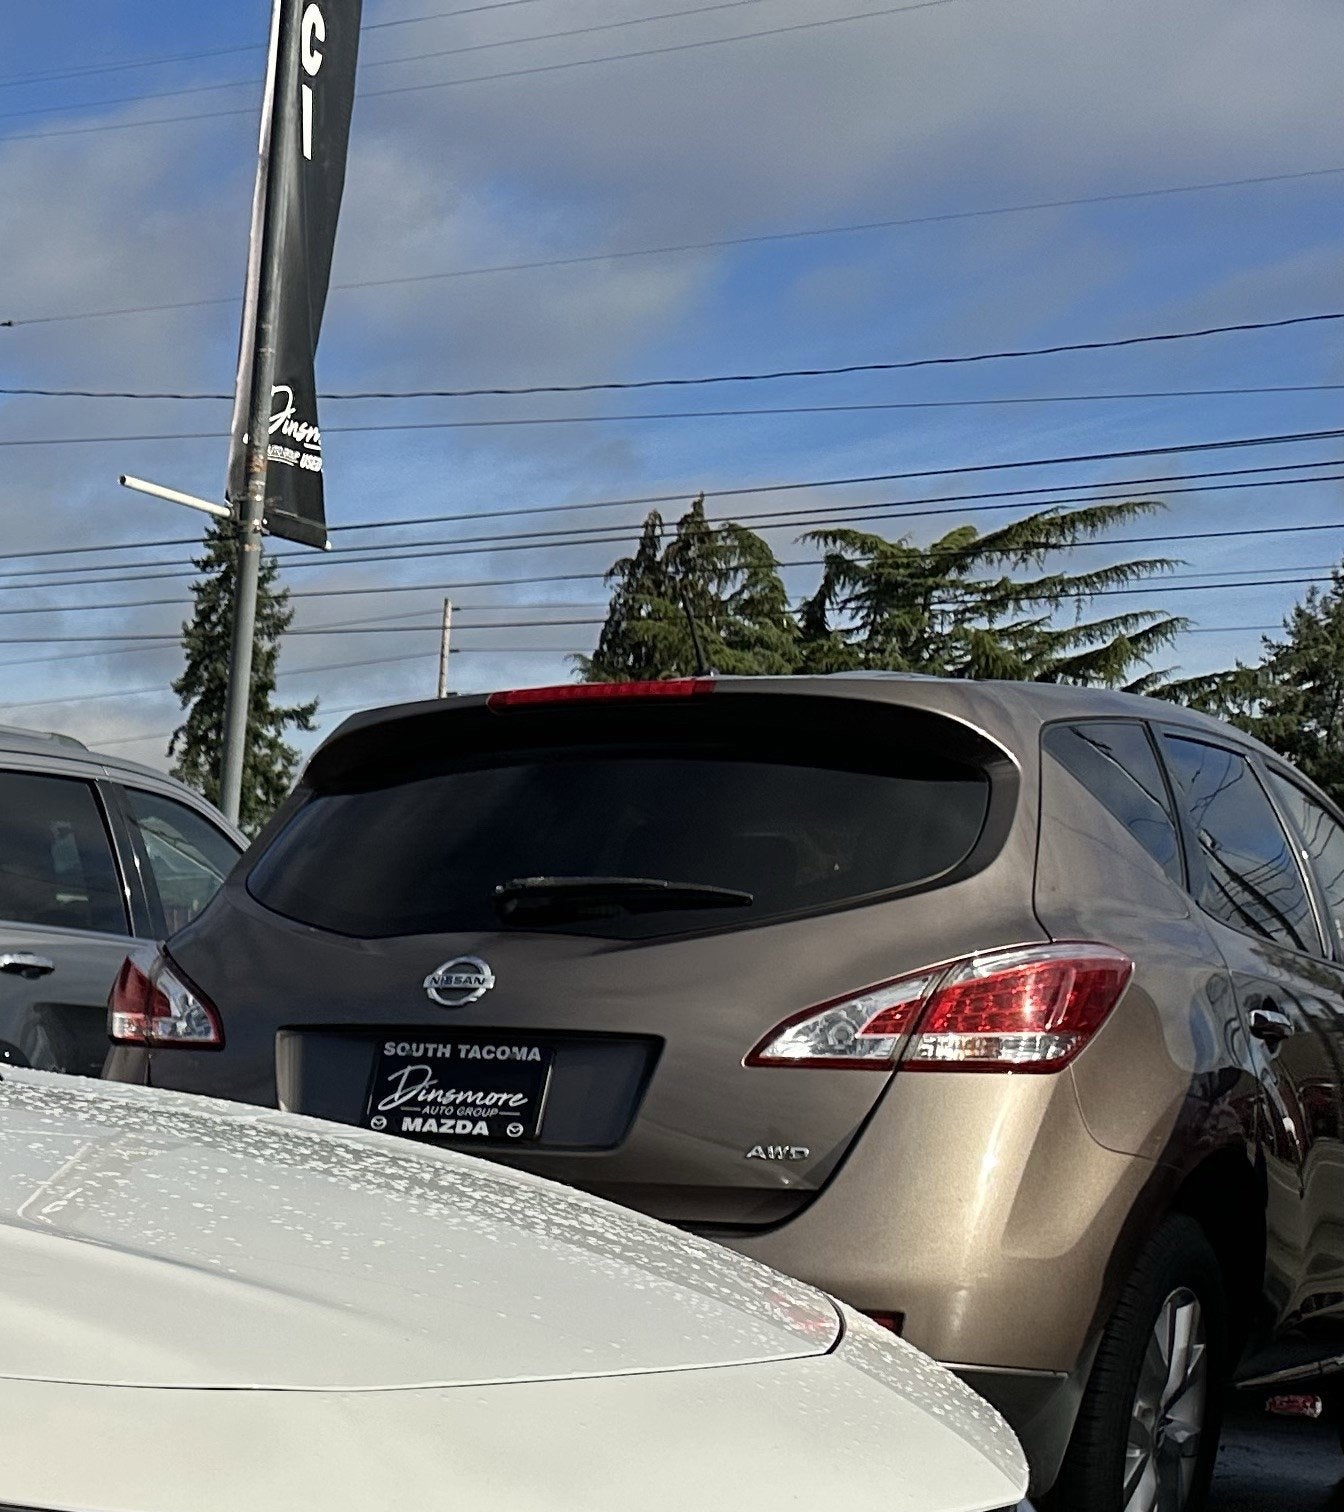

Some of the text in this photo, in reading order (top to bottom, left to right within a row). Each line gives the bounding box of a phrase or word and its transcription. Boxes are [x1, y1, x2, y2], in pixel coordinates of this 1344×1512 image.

[429, 975, 486, 986] NISSAN
[383, 1041, 542, 1062] SOUTH TACOMA
[377, 1063, 529, 1111] Dinsmore
[421, 1103, 499, 1117] AUTO GROUP
[401, 1116, 490, 1136] MAZDA
[745, 1145, 810, 1160] AWD
